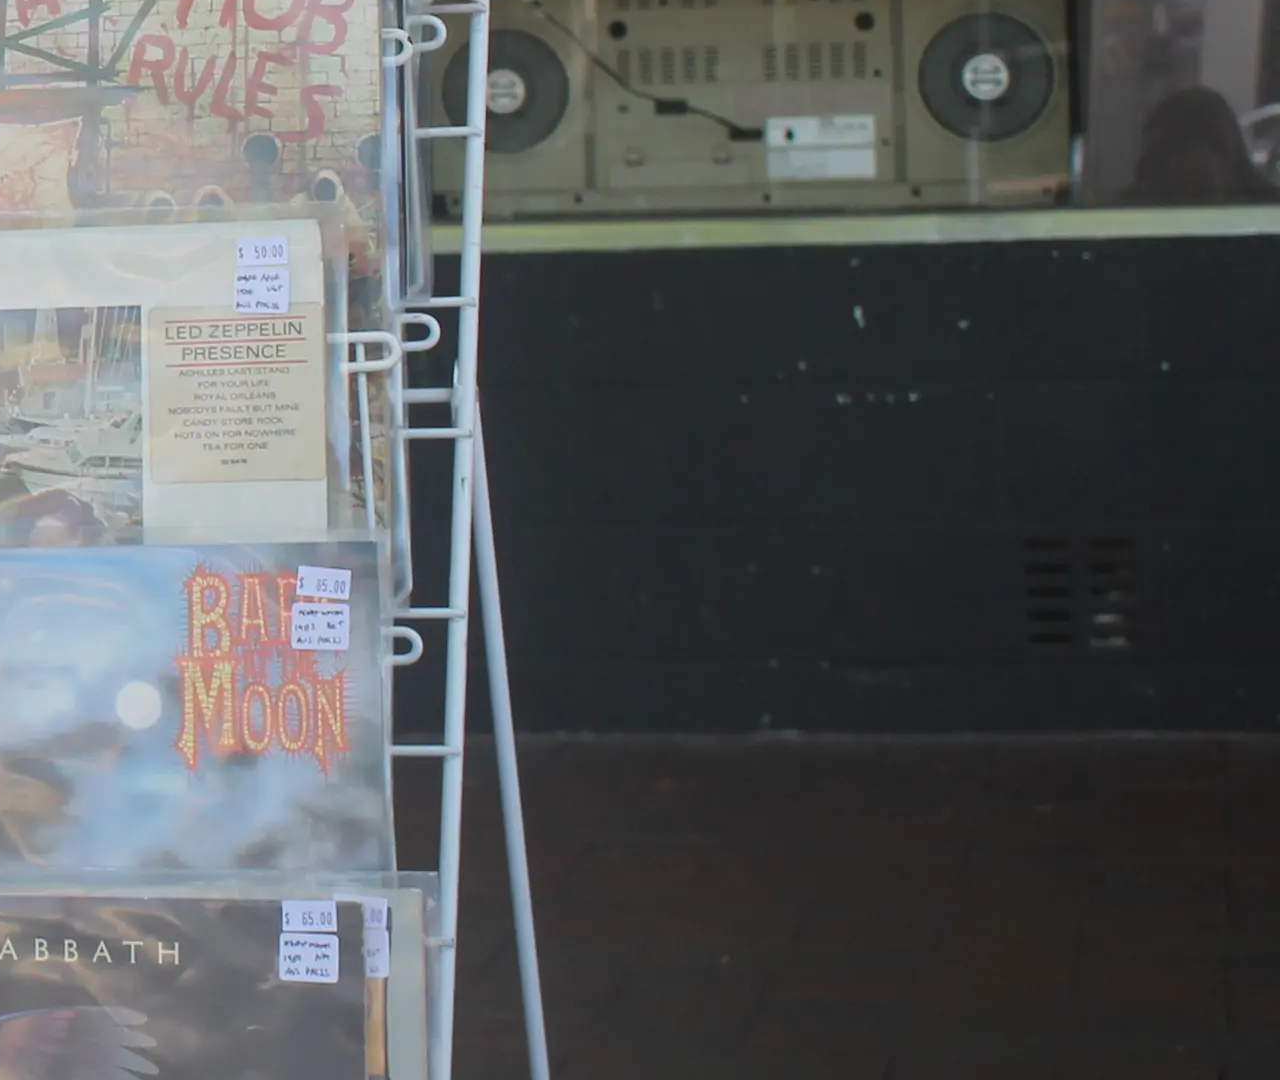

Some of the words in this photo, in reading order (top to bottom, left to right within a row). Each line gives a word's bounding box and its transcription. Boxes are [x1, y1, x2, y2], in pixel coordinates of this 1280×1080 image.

[127, 33, 345, 144] RULES
[254, 243, 284, 260] 50.00
[165, 323, 202, 340] LED
[207, 320, 303, 339] ZEPPELIN
[181, 343, 287, 362] PRESENCE
[178, 368, 226, 379] ACHILLES
[227, 367, 252, 377] LAST
[253, 366, 290, 376] STAND
[197, 380, 217, 389] FOR
[220, 379, 249, 389] YOUR
[251, 378, 270, 388] LIFE
[193, 393, 227, 402] ROYAL
[230, 391, 277, 401] ORLEANS
[219, 405, 250, 414] FAULT
[252, 404, 272, 413] BUT
[275, 403, 300, 412] MINE
[183, 418, 217, 428] CANDY
[221, 417, 253, 427] STORE
[256, 416, 284, 425] ROCK
[174, 431, 202, 441] HOTS
[204, 430, 220, 439] ON
[222, 429, 242, 438] FOR
[244, 428, 297, 438] NOWHERE
[202, 443, 222, 452] TEA
[223, 441, 245, 451] FOR
[246, 441, 269, 450] ONE
[175, 657, 352, 773] MOON
[301, 911, 333, 926] 65.00
